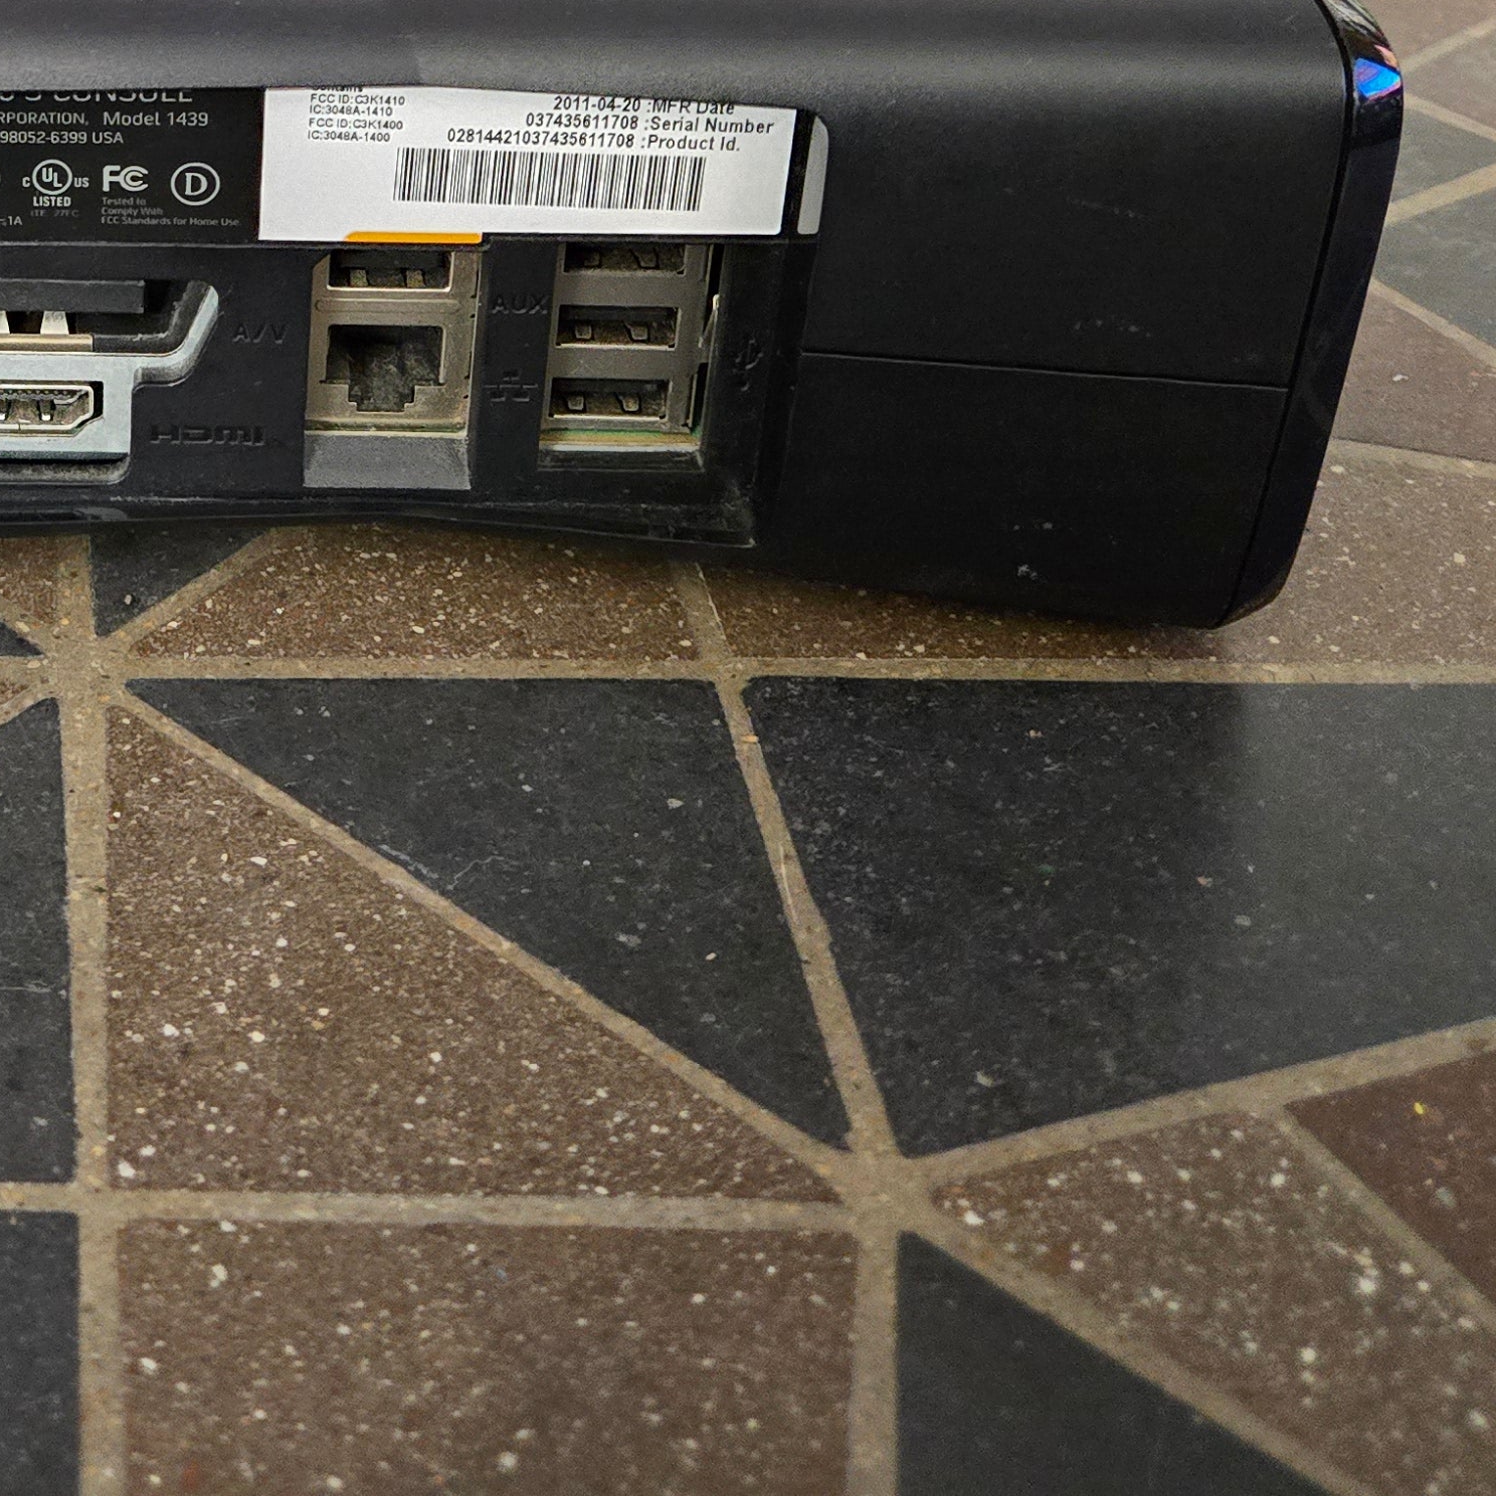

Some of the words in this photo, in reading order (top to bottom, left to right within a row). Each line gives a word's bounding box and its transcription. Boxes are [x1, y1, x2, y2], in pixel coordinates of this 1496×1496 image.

[311, 94, 335, 104] FCC
[554, 96, 641, 112] 2011-04-20
[104, 111, 160, 126] Model
[167, 112, 209, 127] 1439
[309, 118, 333, 128] FCC
[526, 112, 639, 130] 037435611708
[705, 118, 774, 134] Number
[0, 131, 87, 144] 98052-6399
[92, 132, 124, 144] USA
[447, 128, 635, 148] 02814421037435611708
[720, 137, 740, 151] Id.
[33, 196, 71, 207] LISTED
[103, 196, 133, 206] Tested
[136, 196, 146, 206] to
[101, 206, 138, 216] Comply
[140, 207, 164, 216] With
[101, 216, 119, 225] FCC
[122, 216, 171, 226] Standards
[173, 217, 187, 226] for
[189, 217, 218, 226] Home
[220, 218, 239, 227] Use
[232, 323, 289, 344] A/V
